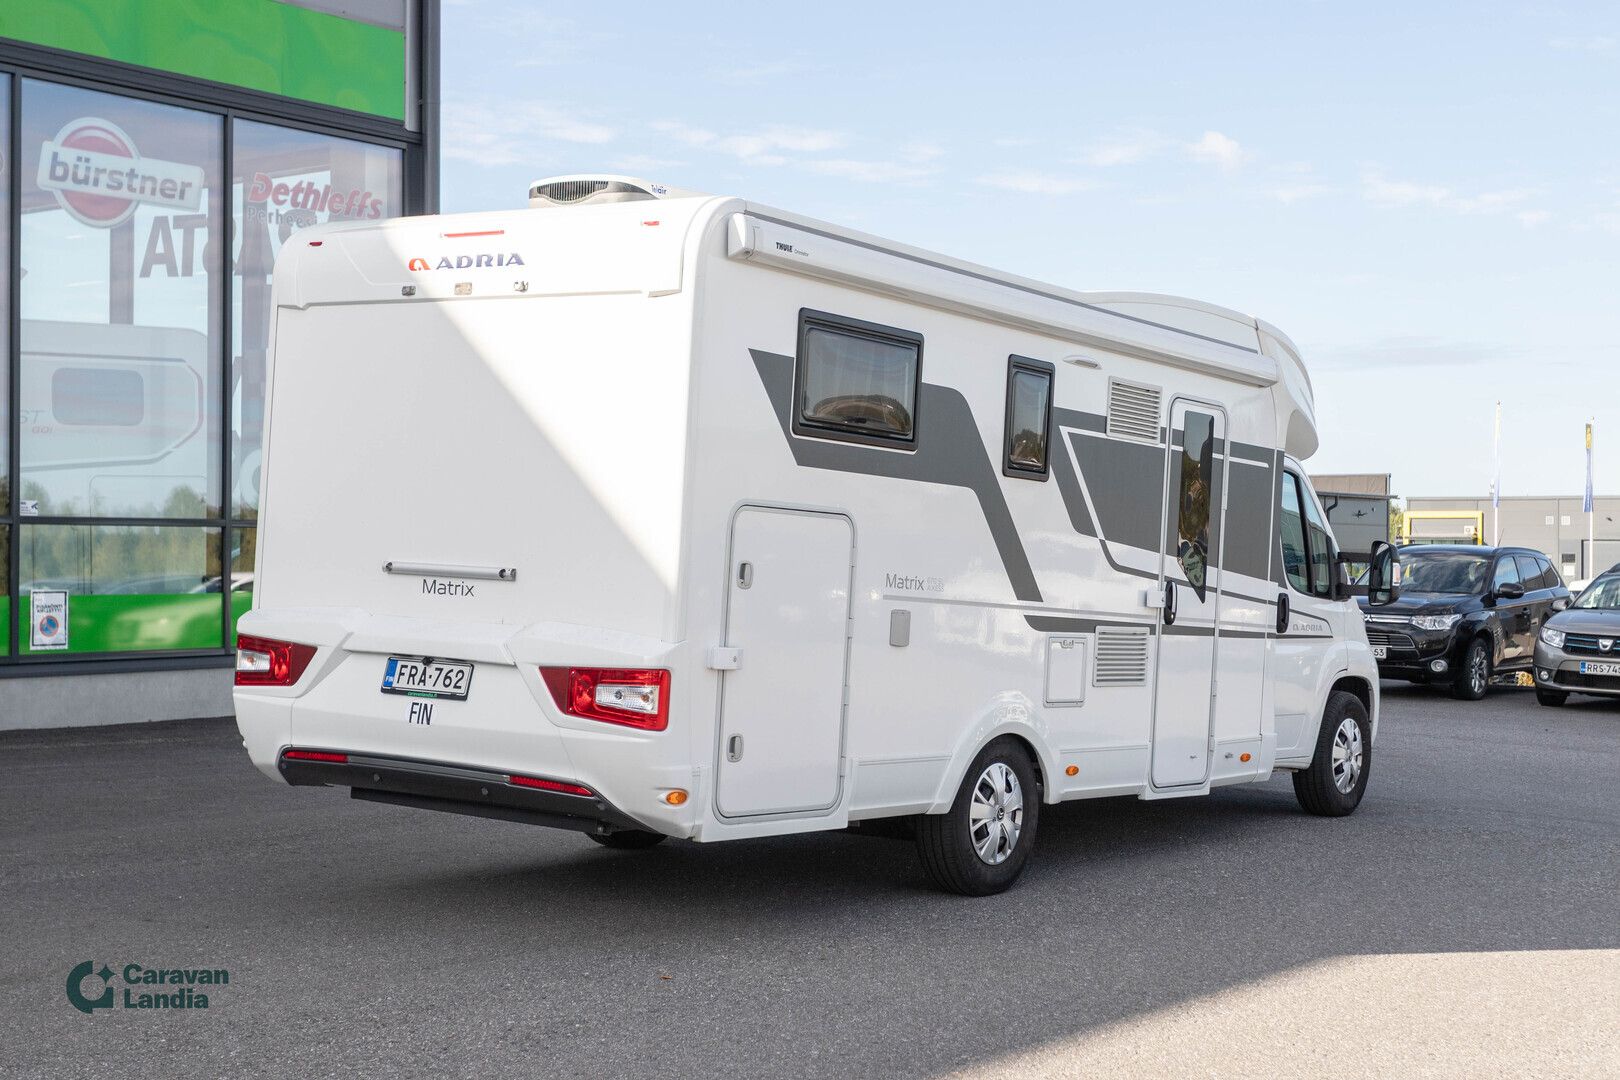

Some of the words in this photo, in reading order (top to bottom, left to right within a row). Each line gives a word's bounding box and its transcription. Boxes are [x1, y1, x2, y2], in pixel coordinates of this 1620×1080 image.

[49, 151, 193, 200] bürstner
[248, 172, 383, 220] Dethleffs
[775, 241, 793, 253] THULE
[436, 252, 526, 270] ADRIA
[422, 578, 475, 597] Matrix
[885, 573, 925, 591] Matrix
[1300, 623, 1323, 632] ADRIA
[397, 665, 464, 689] FRA-762
[409, 702, 433, 725] FIN
